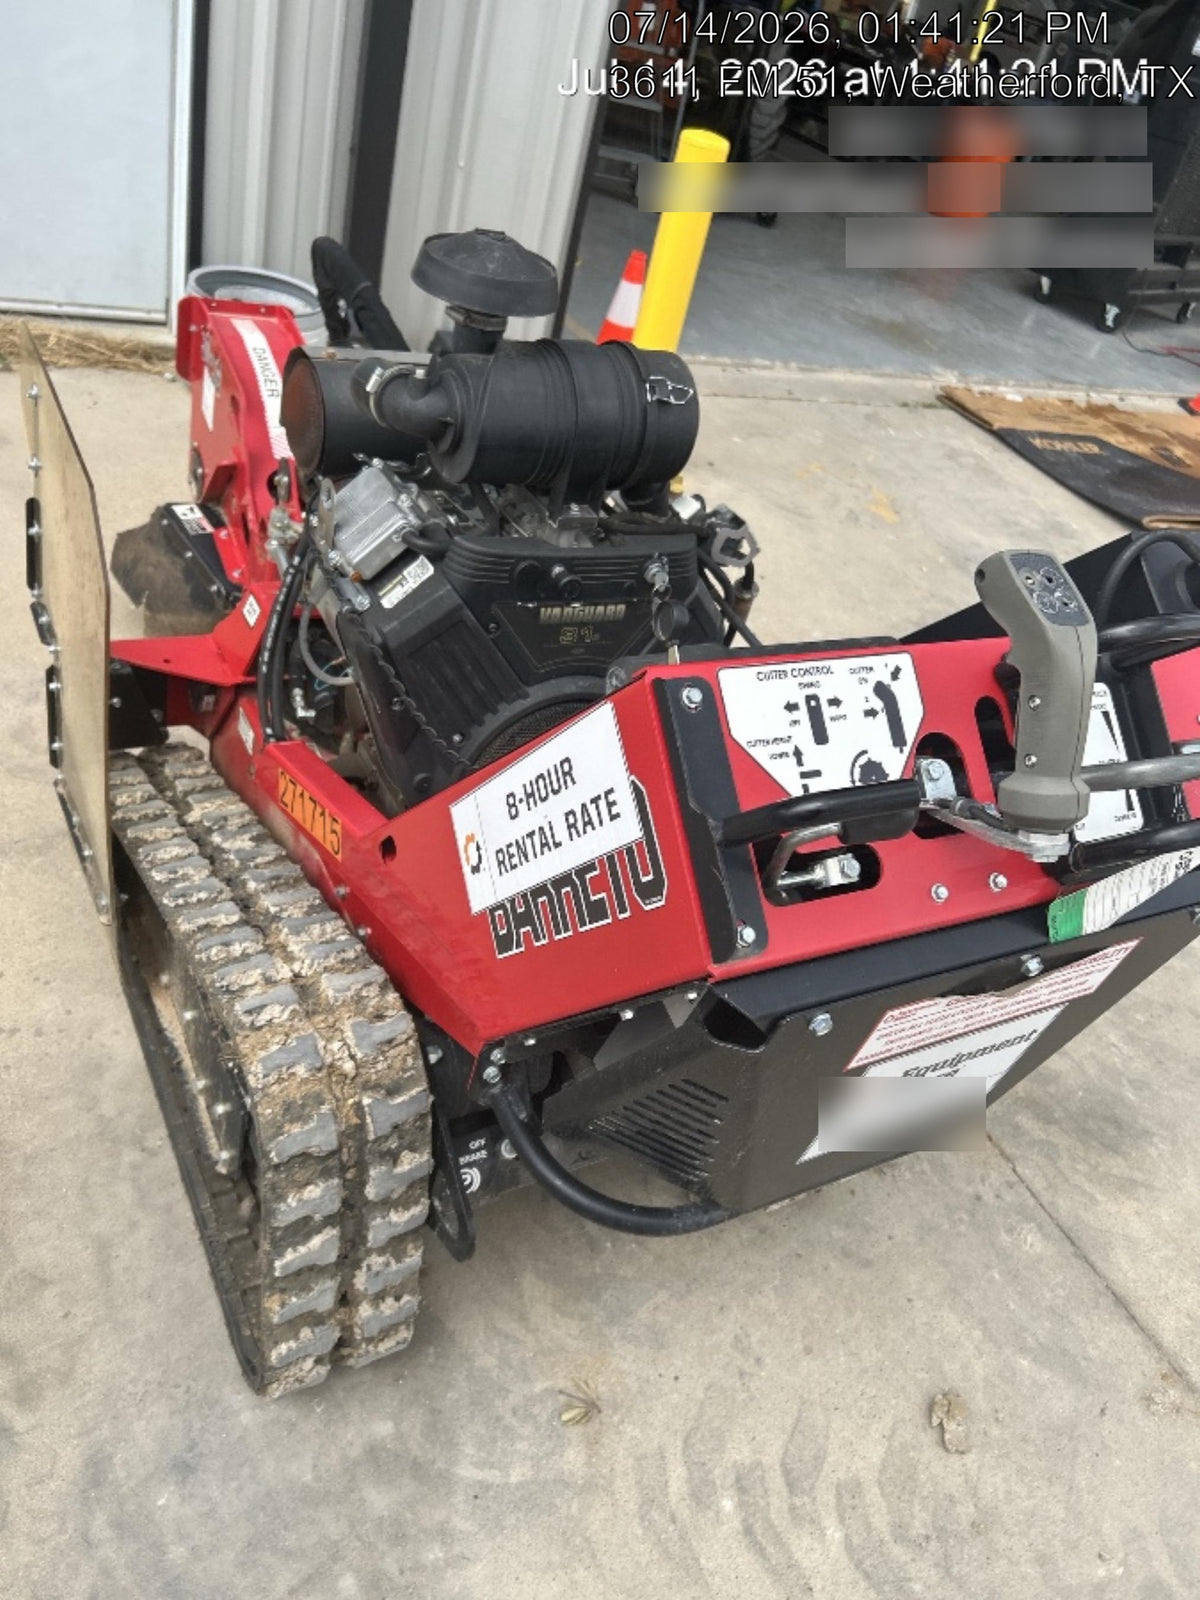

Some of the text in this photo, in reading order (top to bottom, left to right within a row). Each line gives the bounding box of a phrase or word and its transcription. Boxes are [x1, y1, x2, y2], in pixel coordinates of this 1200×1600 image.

[539, 603, 627, 624] VANGUARD
[791, 665, 834, 678] CONTROL
[280, 770, 341, 856] 271715
[505, 756, 577, 821] 8-HOUR
[495, 786, 622, 876] RENTAL RATE
[902, 1028, 1038, 1077] Equipment
